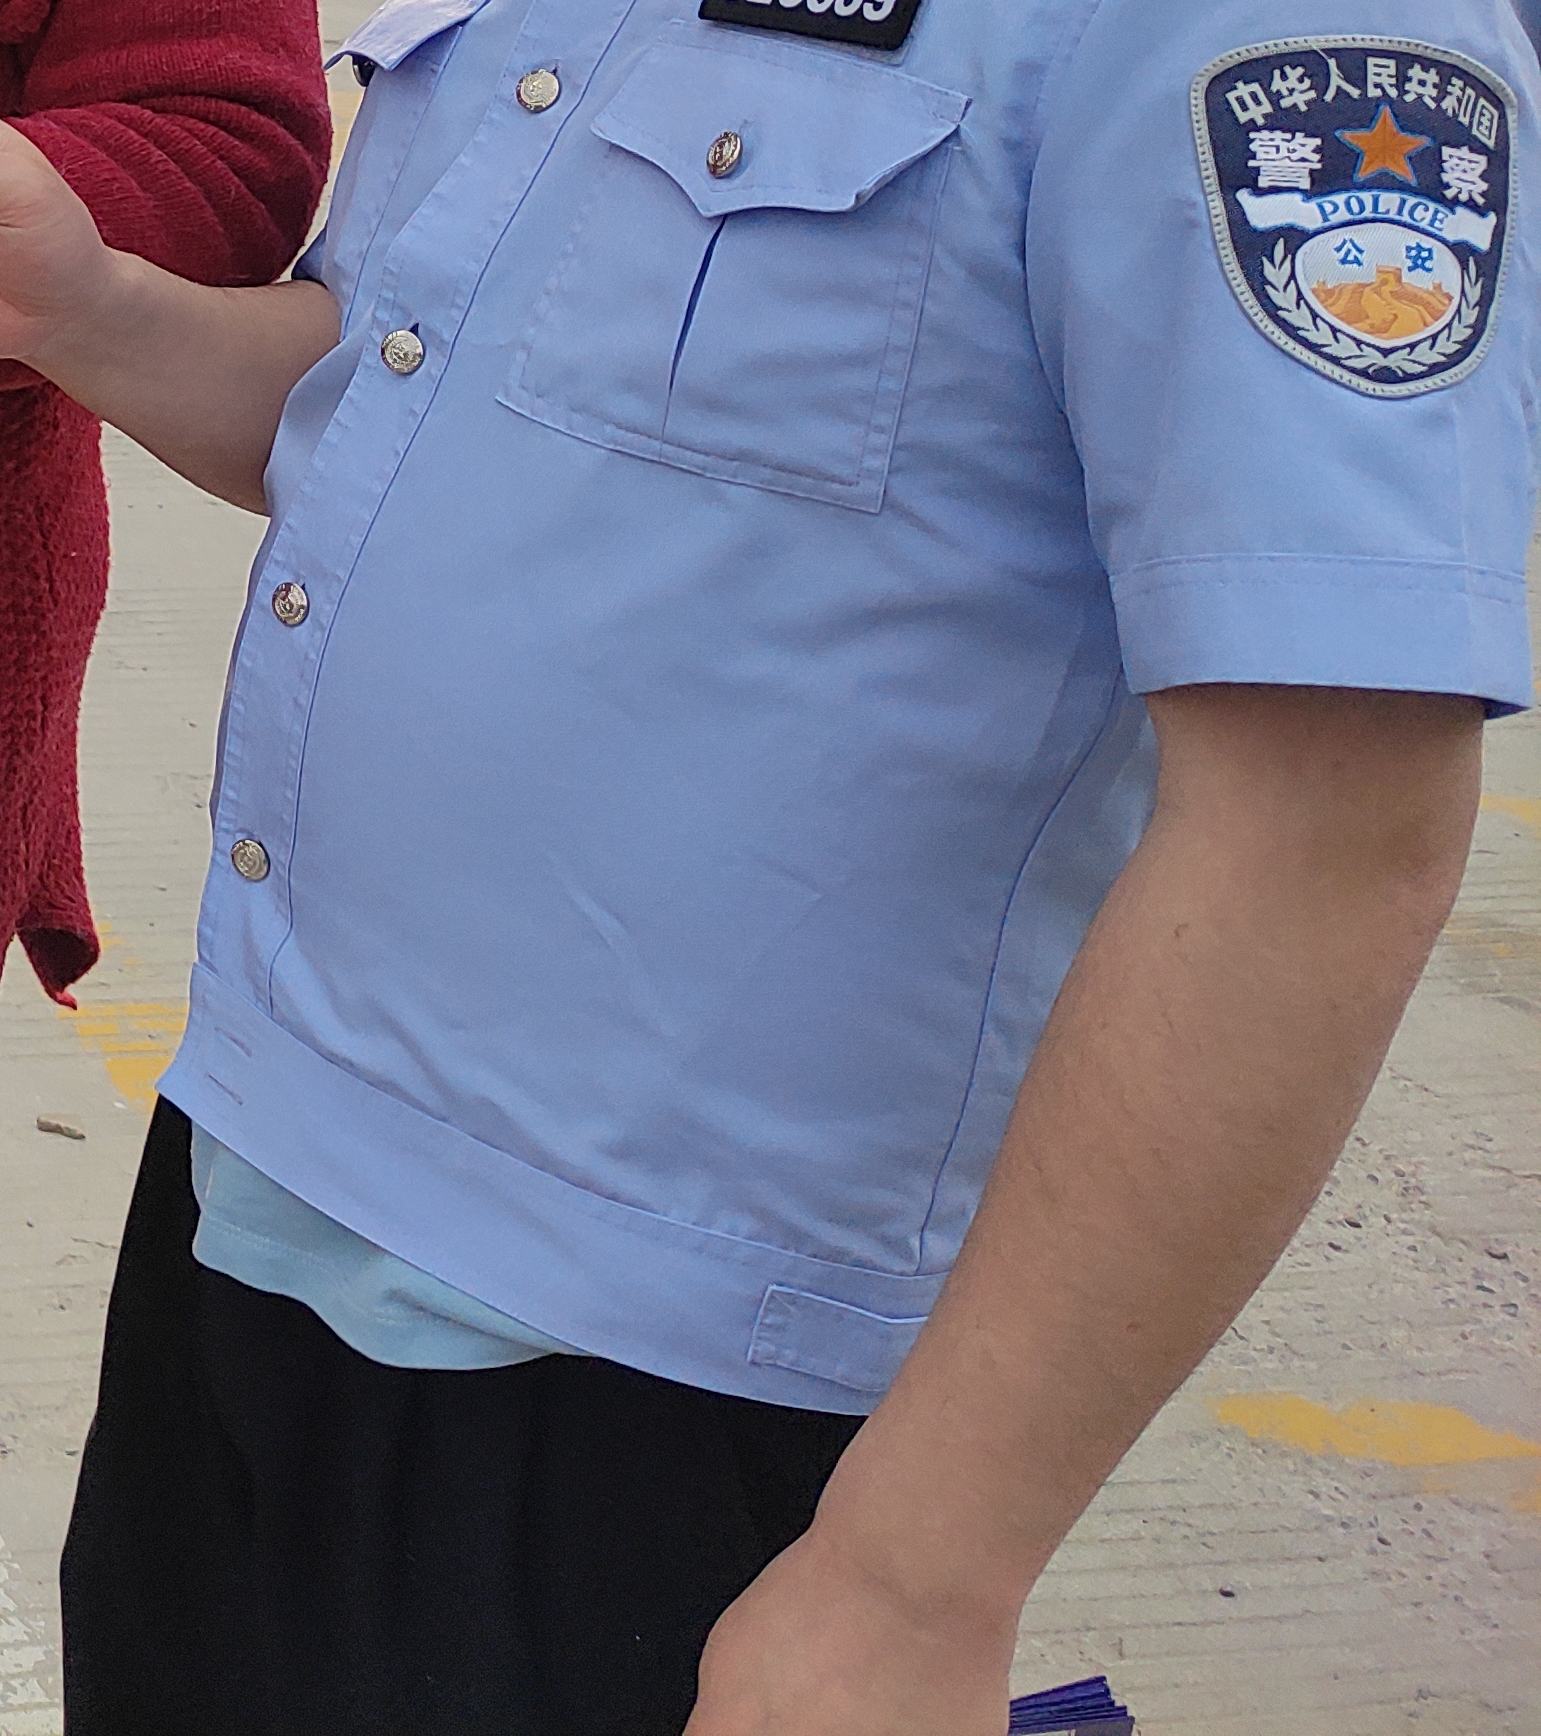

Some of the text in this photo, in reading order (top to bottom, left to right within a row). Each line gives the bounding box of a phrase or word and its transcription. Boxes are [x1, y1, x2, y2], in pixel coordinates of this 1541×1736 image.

[1225, 57, 1499, 150] 中华人民共和国
[1316, 193, 1449, 232] POLICE
